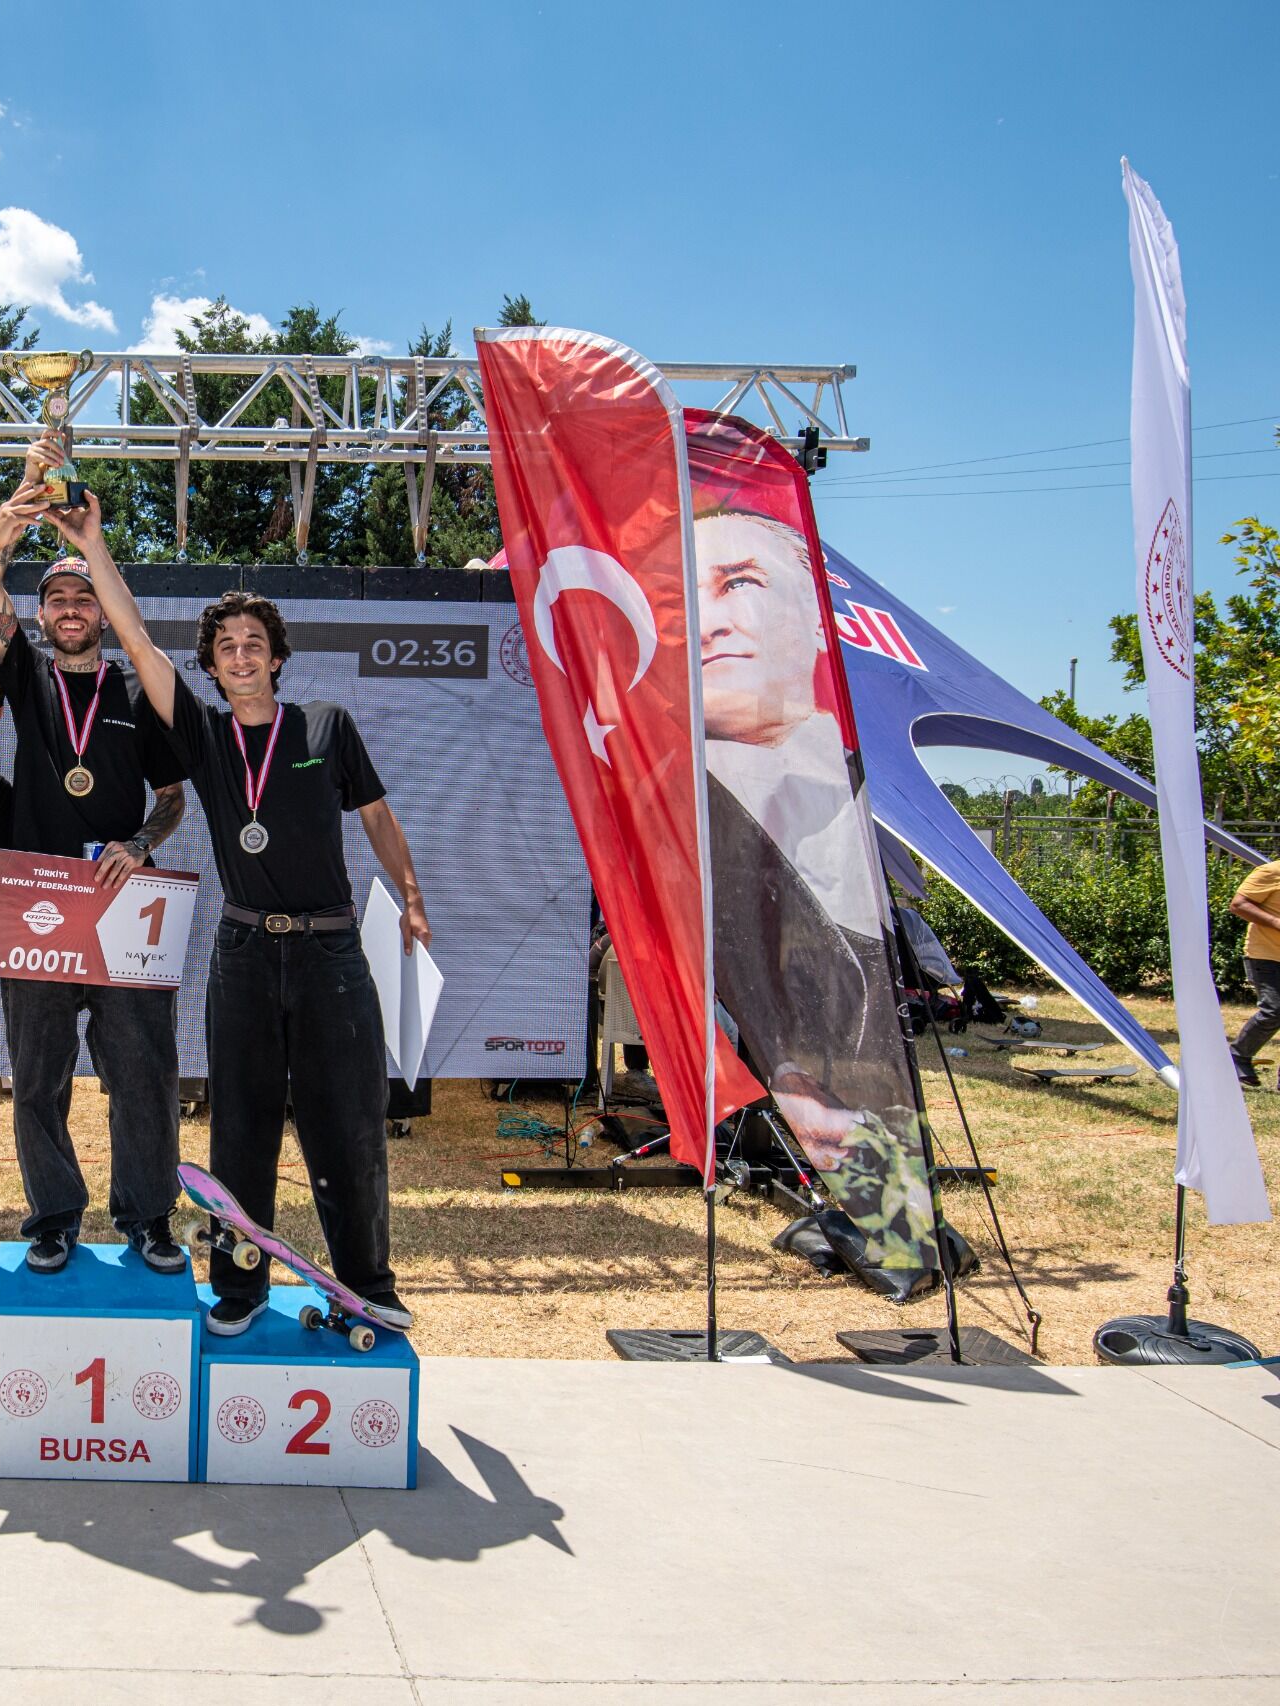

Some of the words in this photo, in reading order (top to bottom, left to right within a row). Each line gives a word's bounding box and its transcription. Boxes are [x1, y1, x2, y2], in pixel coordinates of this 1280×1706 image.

[371, 639, 477, 667] 02:36
[1, 876, 35, 889] KAYKAY
[36, 880, 95, 894] FEDERASYONU
[33, 867, 69, 879] TÜRKİYE
[139, 897, 167, 946] 1
[74, 1357, 107, 1424] 1
[285, 1389, 332, 1456] 2
[39, 1437, 151, 1463] BURSA
